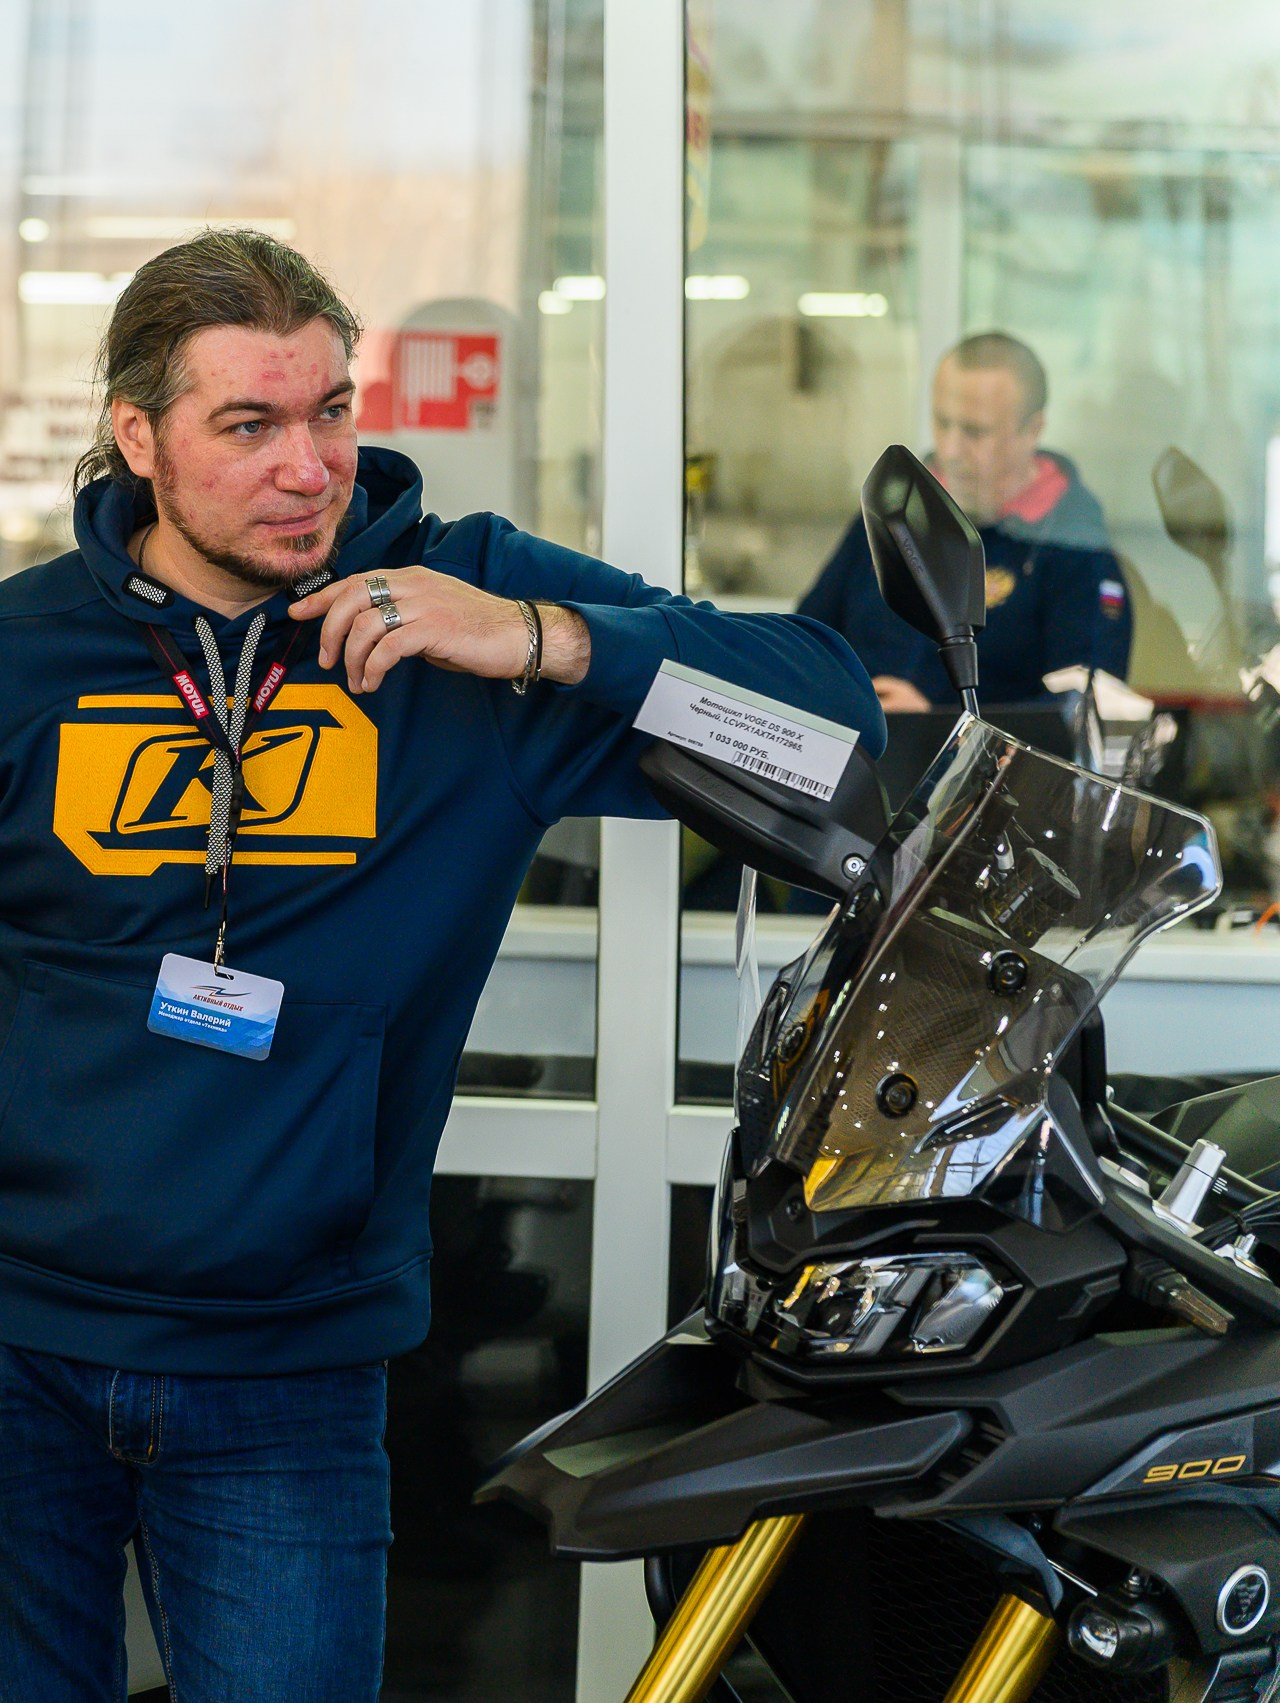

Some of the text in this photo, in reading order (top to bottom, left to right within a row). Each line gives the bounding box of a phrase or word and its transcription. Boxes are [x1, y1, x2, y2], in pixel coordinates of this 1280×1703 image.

[175, 674, 206, 716] MOTUL
[255, 666, 283, 710] MOTUL
[689, 703, 721, 722] Черный,
[700, 696, 743, 718] Мотоцикл
[744, 712, 768, 728] VOGE
[768, 722, 781, 732] DS
[781, 727, 796, 738] 900
[709, 731, 715, 739] 1
[715, 733, 731, 745] 033
[732, 740, 748, 751] 000
[749, 746, 769, 760] РУБ.
[160, 1001, 232, 1028] Уткин Валерий
[193, 994, 244, 1012] АКТИВНЫЙ ОТДЫХ
[1143, 1454, 1247, 1484] 900
